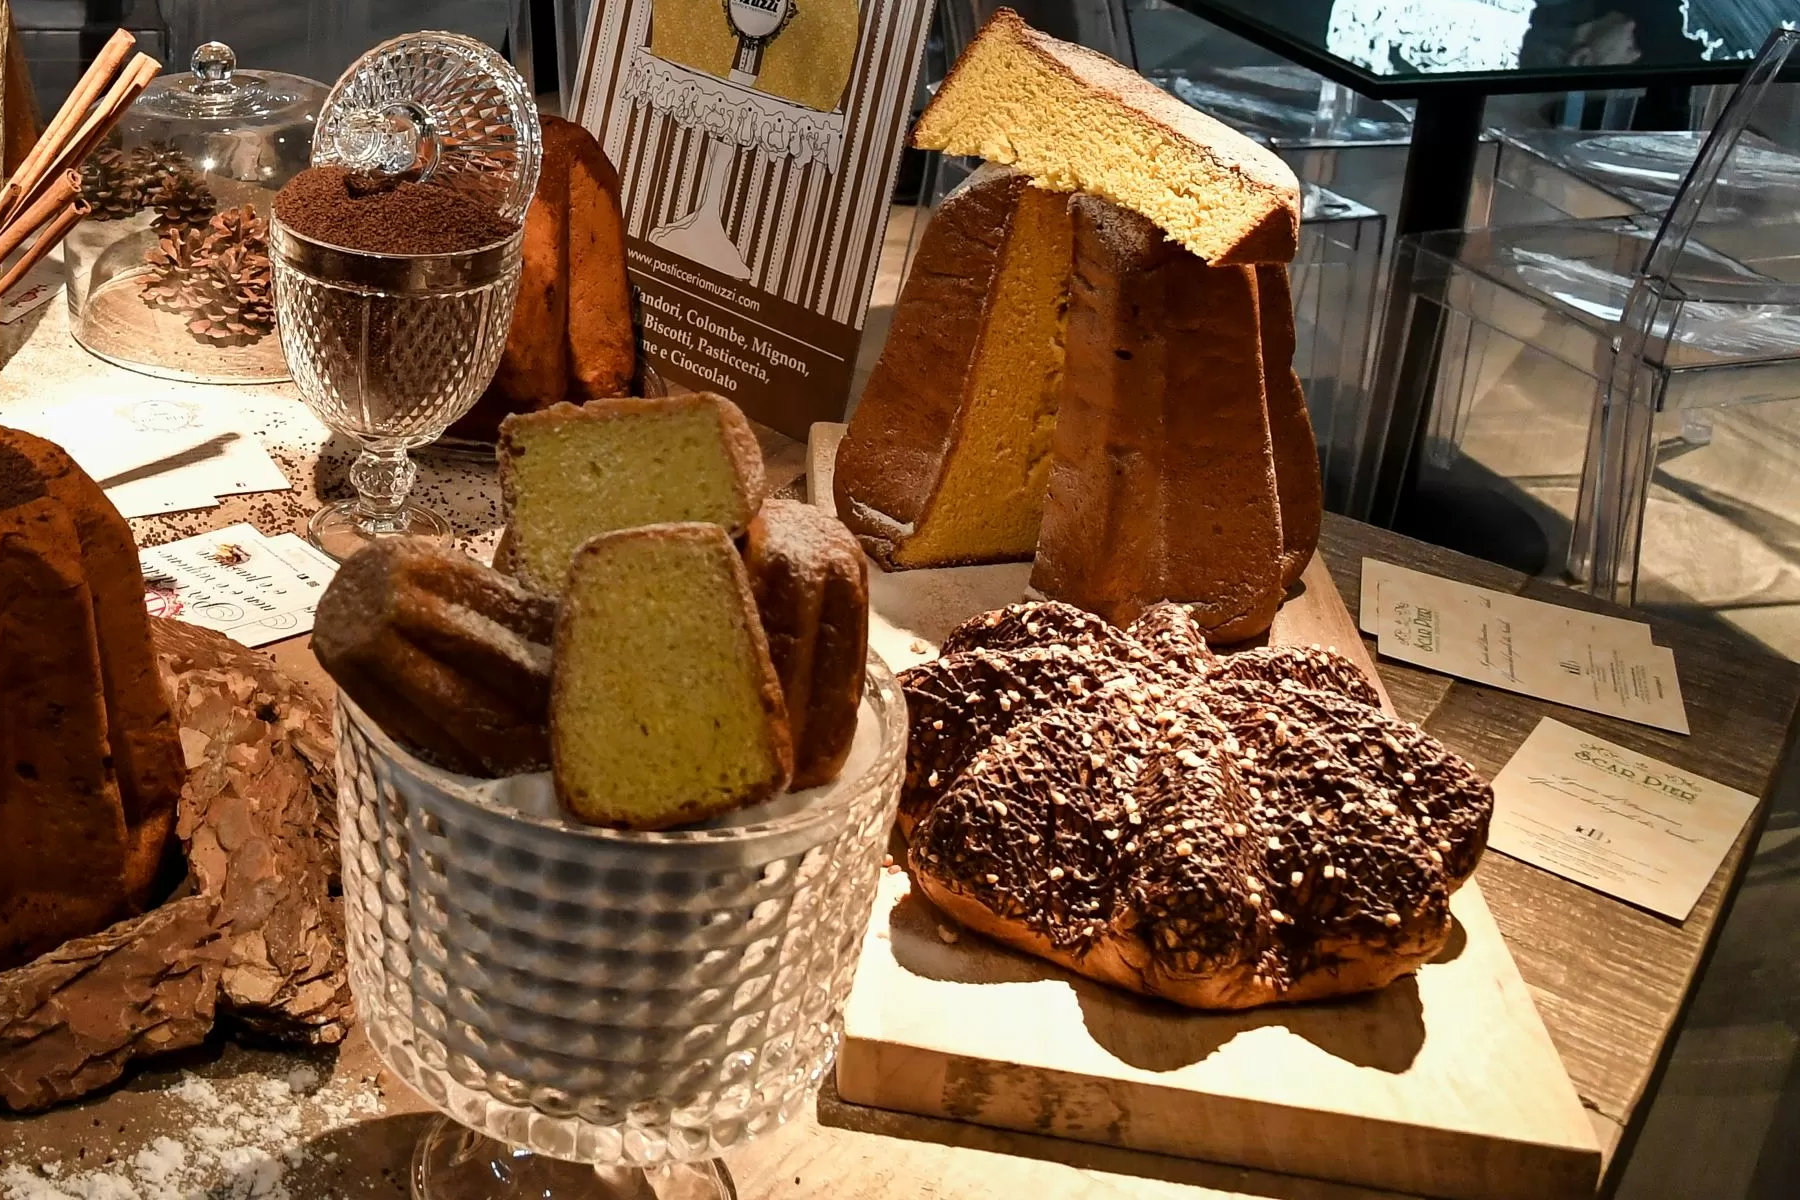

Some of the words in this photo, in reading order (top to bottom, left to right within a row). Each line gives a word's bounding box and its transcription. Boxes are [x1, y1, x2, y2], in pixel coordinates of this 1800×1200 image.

[627, 247, 761, 312] www.pasticceriamuzzi.com
[644, 313, 695, 351] Biscotti,
[697, 337, 772, 385] Pasticceria,
[659, 349, 668, 360] e
[671, 349, 738, 392] Cioccolato
[686, 309, 749, 350] Colombe,
[751, 336, 811, 378] Mignon,
